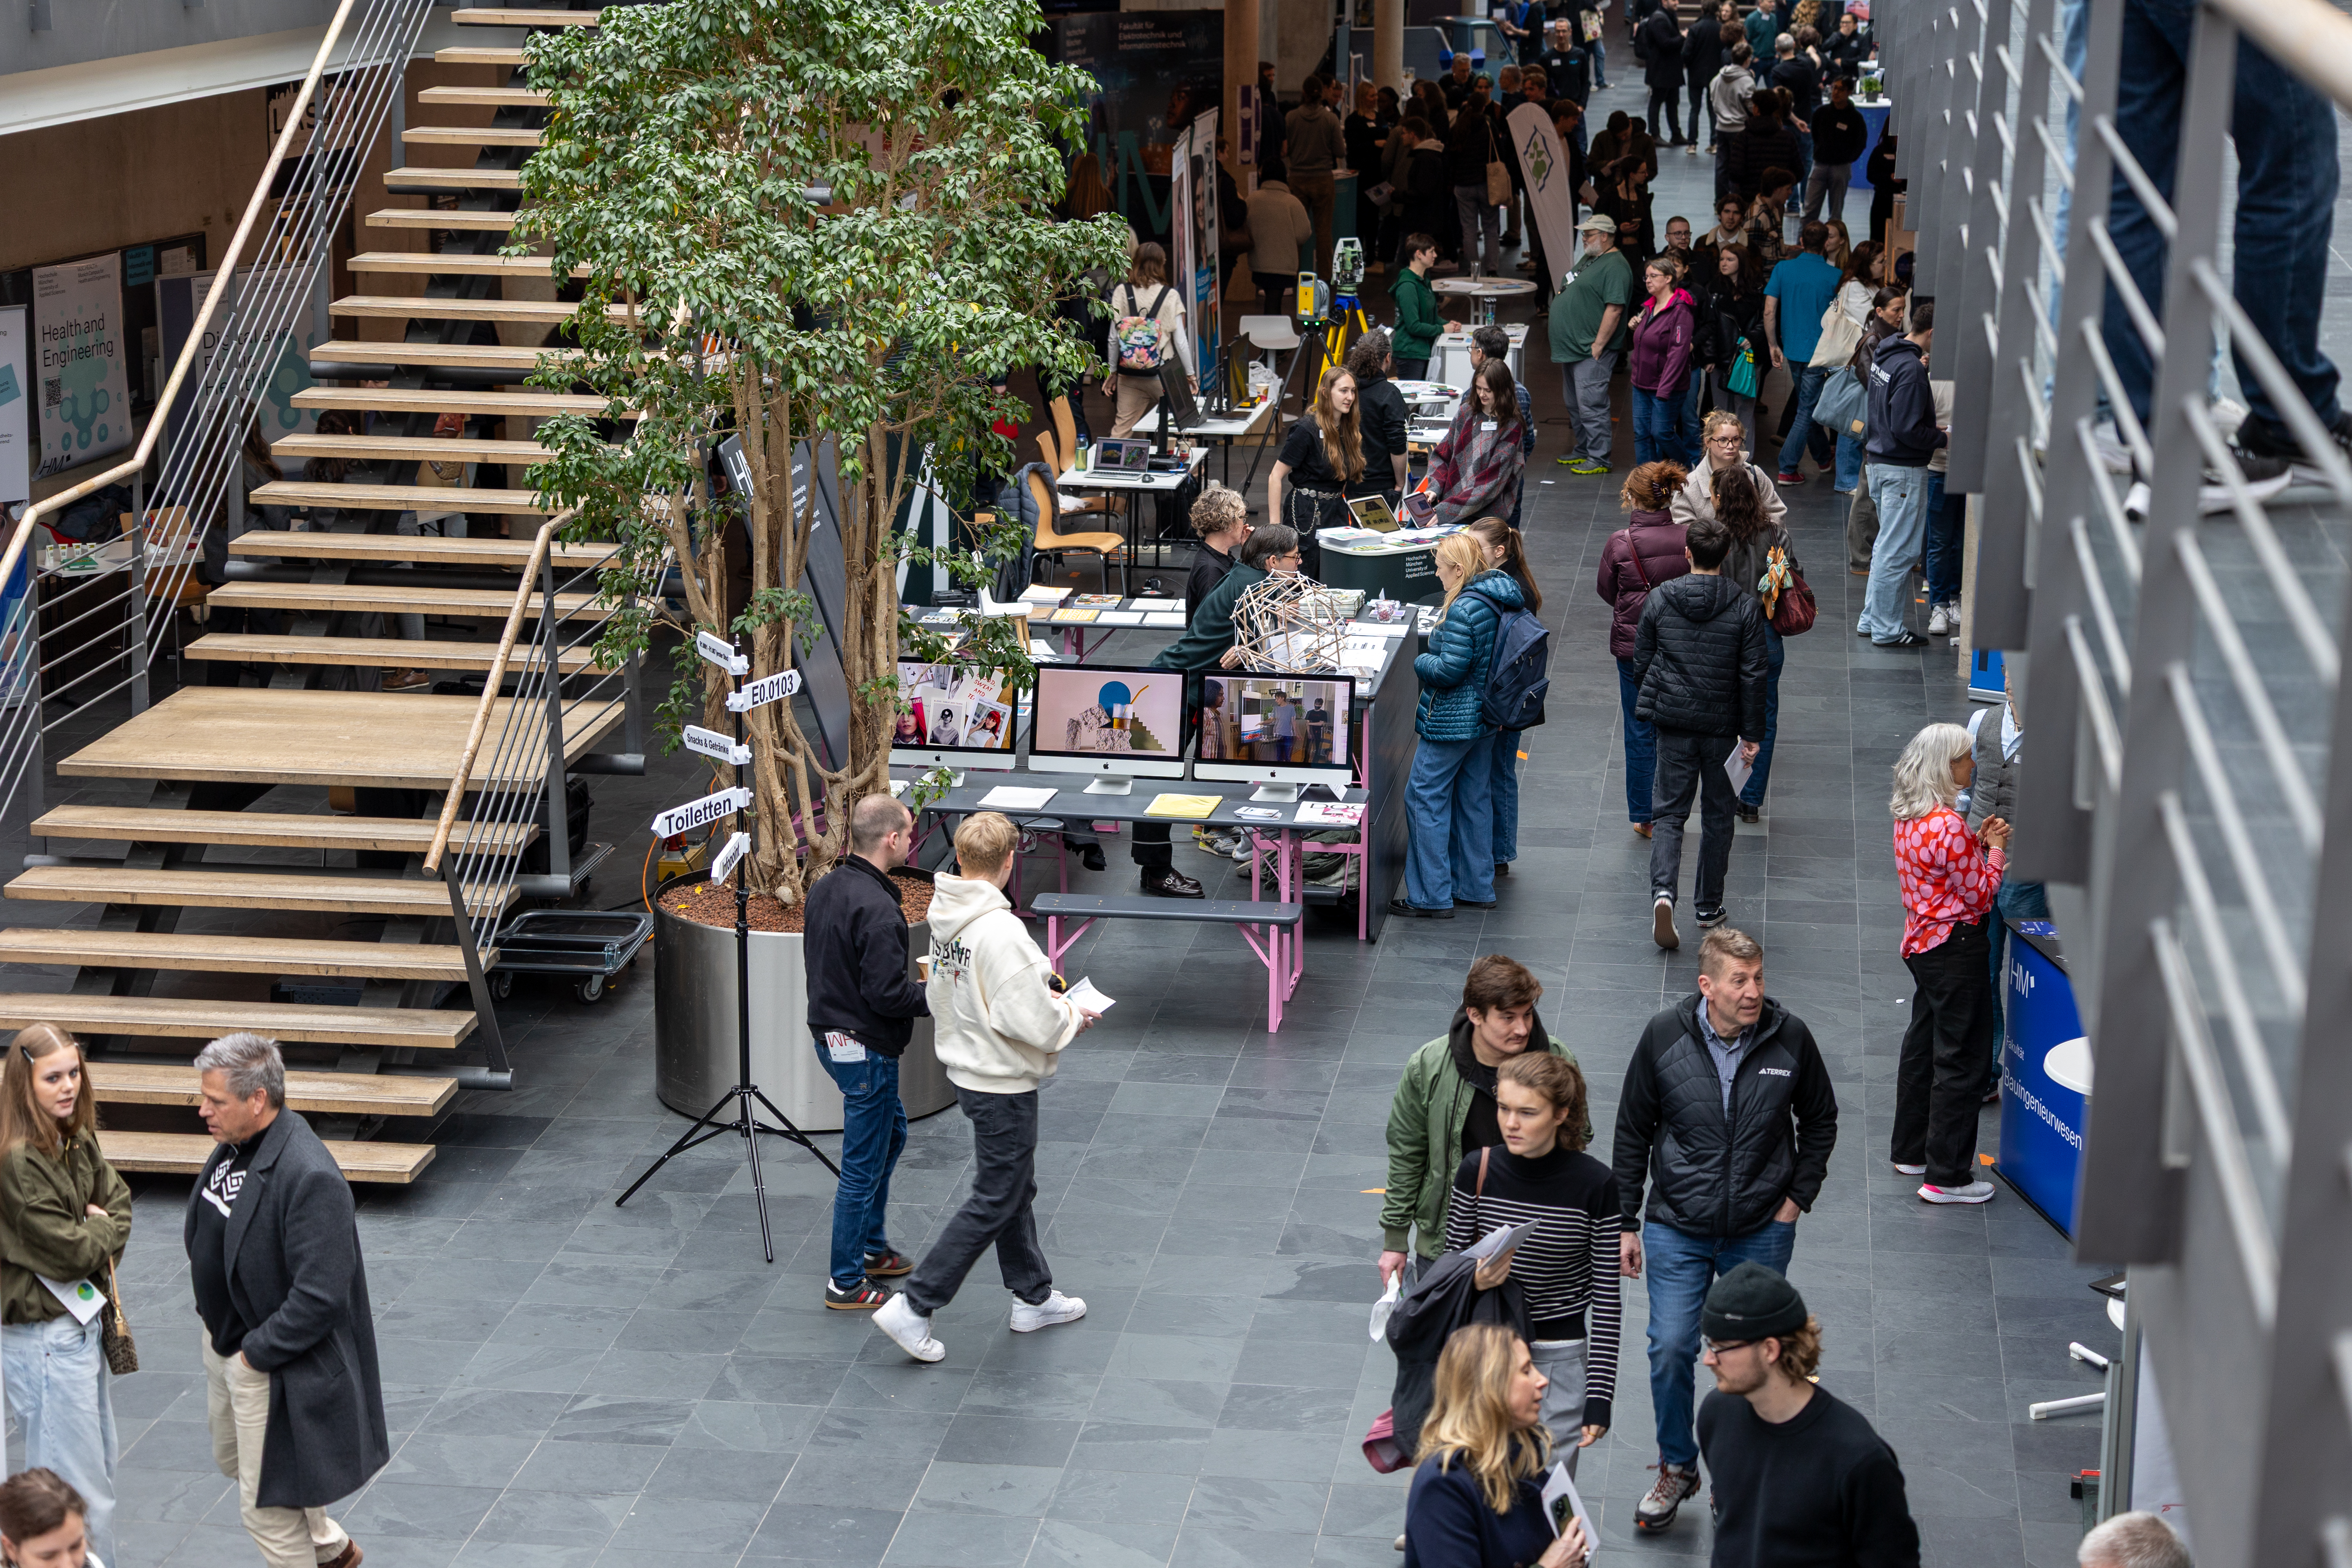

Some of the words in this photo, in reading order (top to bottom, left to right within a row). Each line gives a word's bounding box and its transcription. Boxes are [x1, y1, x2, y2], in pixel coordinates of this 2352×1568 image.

[42, 318, 81, 343] Health
[83, 312, 105, 334] and
[203, 328, 257, 351] Digtal
[43, 339, 114, 368] Engineering
[204, 351, 257, 373] Pulic
[205, 372, 272, 396] Helthh
[752, 674, 793, 706] E0.0103
[973, 688, 986, 697] AND
[974, 679, 993, 692] SWEAT
[687, 733, 703, 747] Snacks
[708, 739, 729, 755] Getränke
[665, 798, 732, 834] Toiletten
[722, 842, 740, 878] Infopoint
[2010, 957, 2029, 998] HM
[2006, 1035, 2024, 1061] Fakultät
[1766, 1068, 1792, 1077] TERREX
[2004, 1066, 2082, 1151] Bauingenieurwesen
